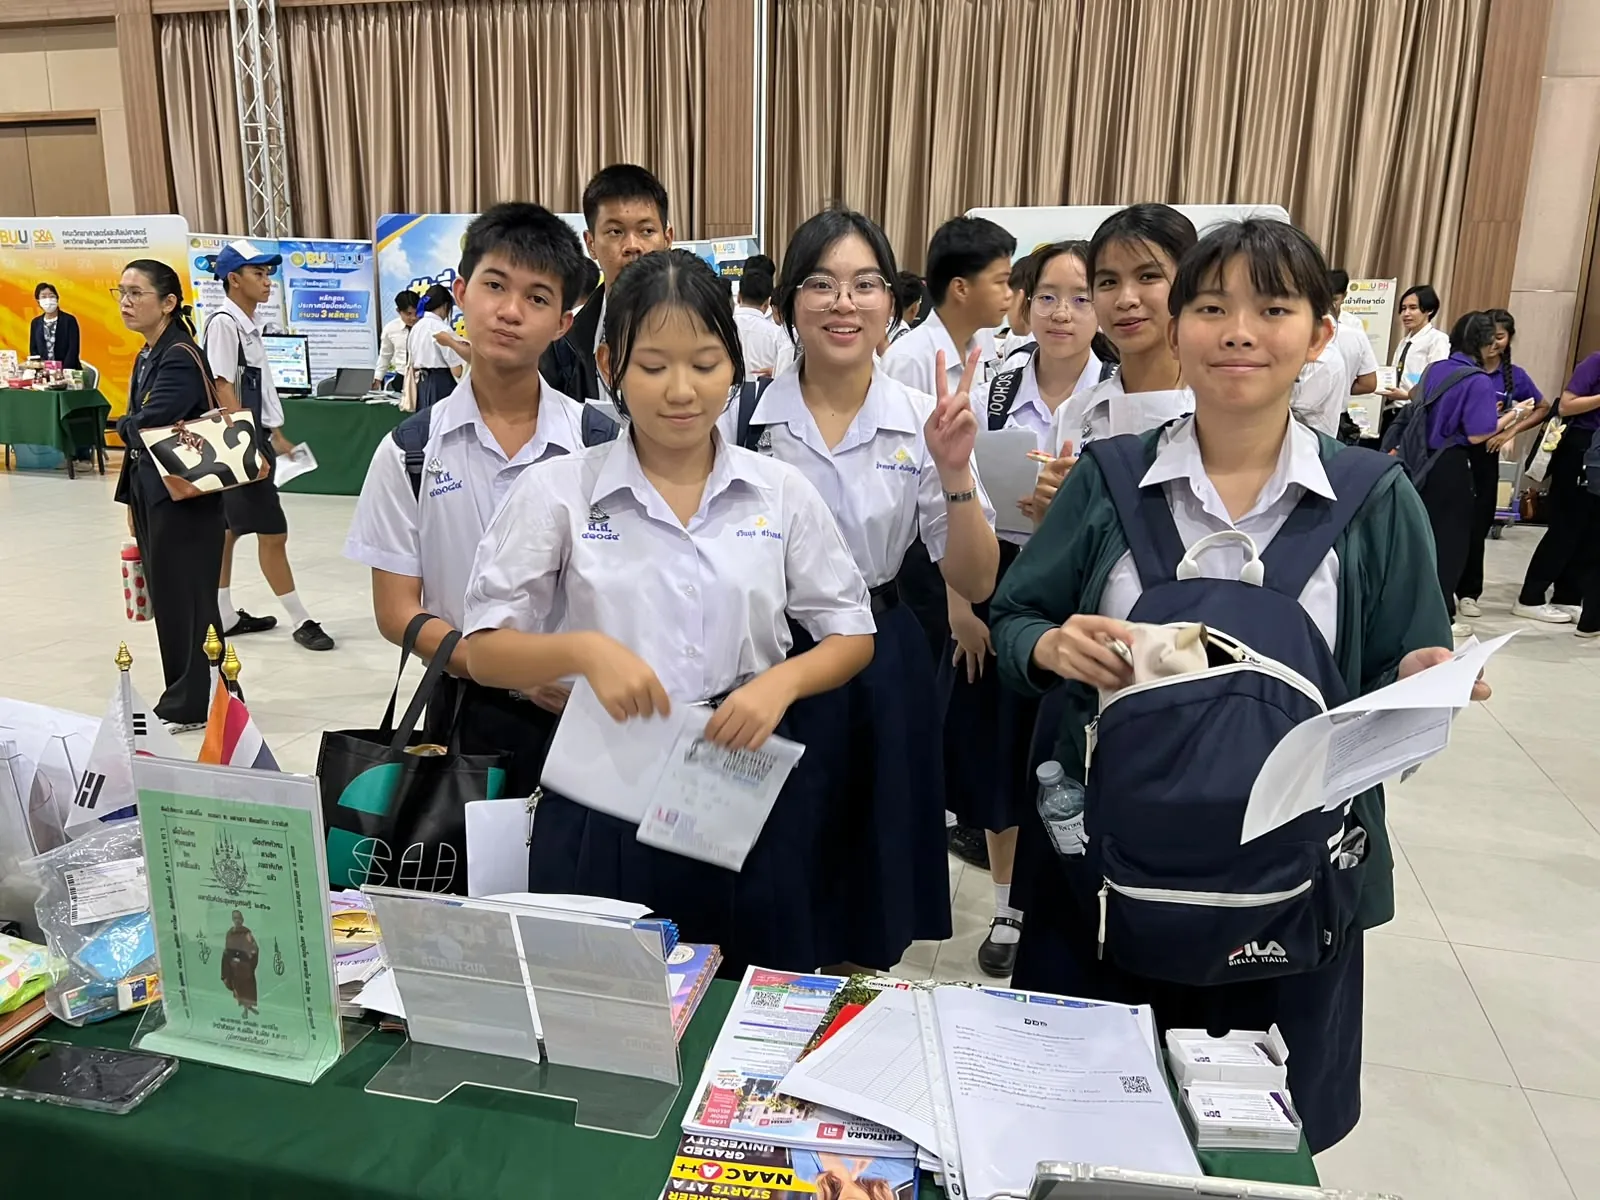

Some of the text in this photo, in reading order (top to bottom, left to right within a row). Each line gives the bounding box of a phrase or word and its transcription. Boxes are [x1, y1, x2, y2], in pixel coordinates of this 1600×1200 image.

[1, 230, 28, 243] BUU
[320, 310, 327, 318] 3
[1228, 940, 1286, 960] FILA
[1228, 957, 1257, 966] BIELLA
[847, 1131, 903, 1142] CHITKARA
[683, 1145, 745, 1160] GRADED
[725, 1167, 793, 1186] NAAC
[672, 1179, 771, 1199] STARTS AT A
